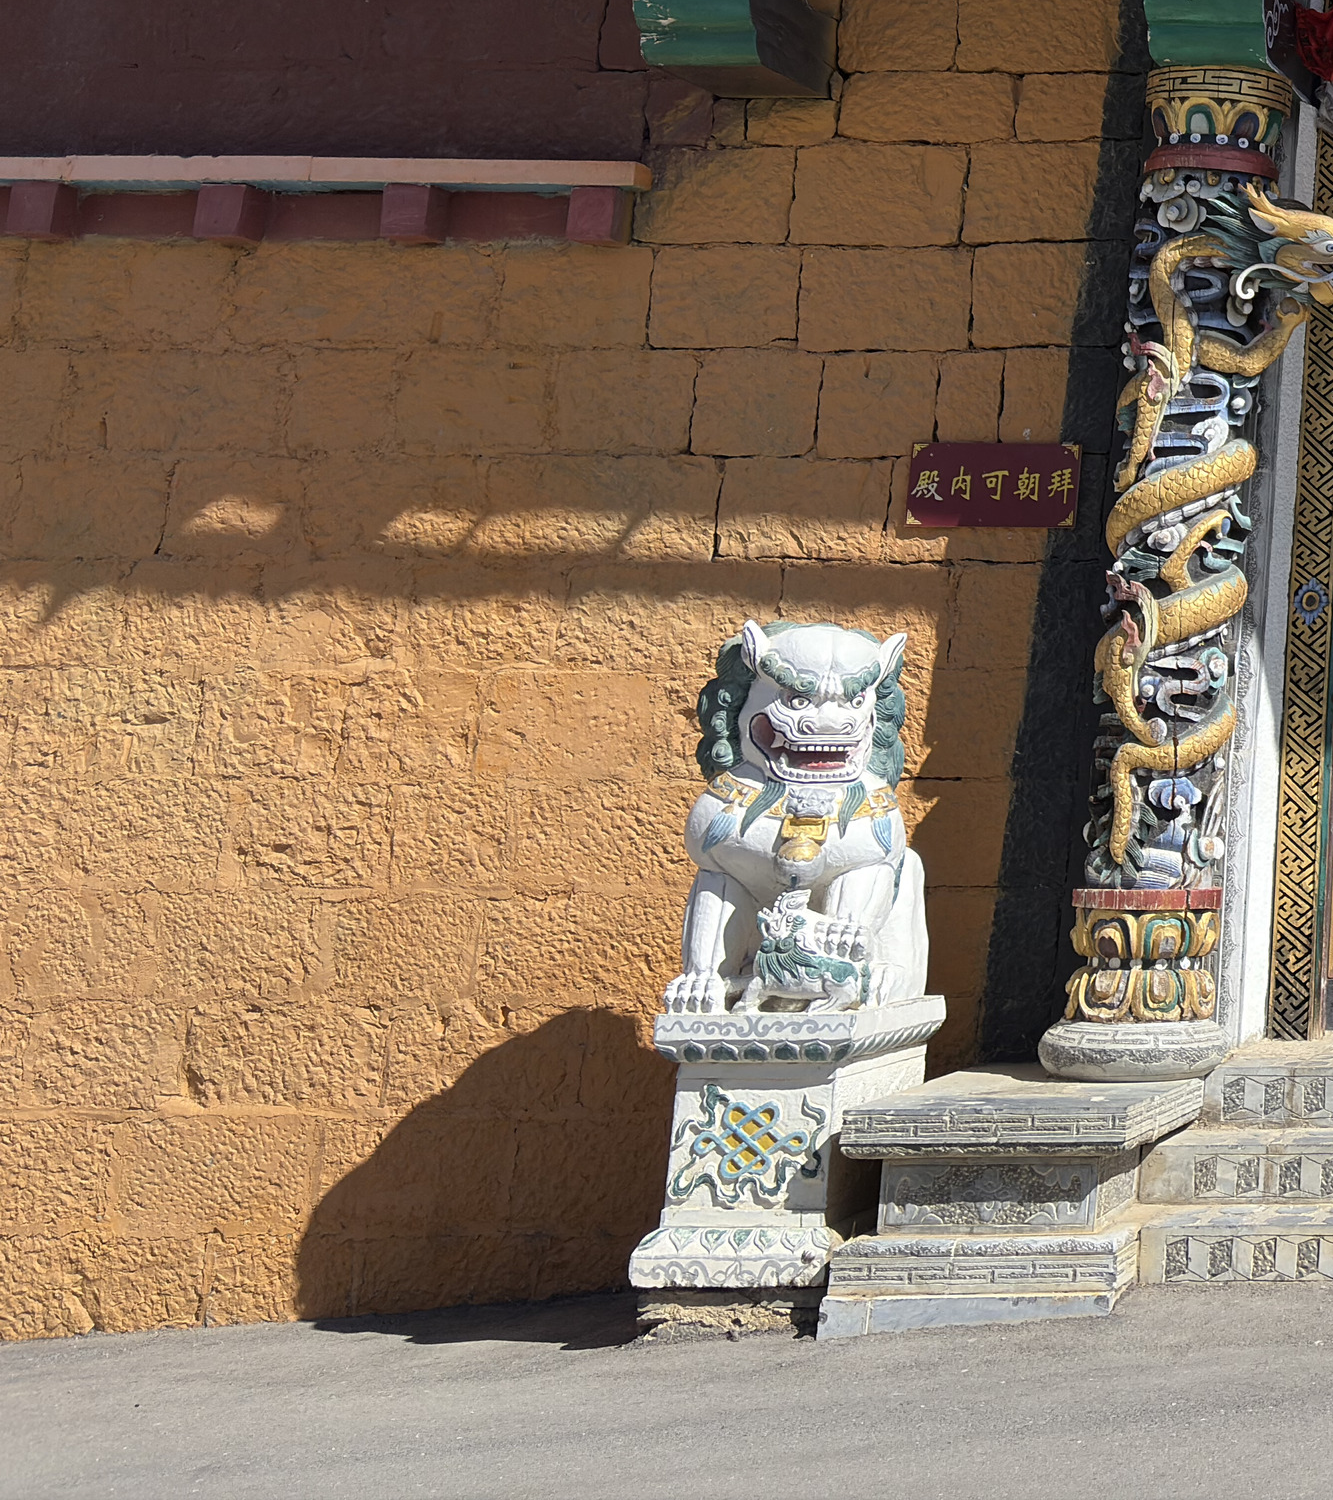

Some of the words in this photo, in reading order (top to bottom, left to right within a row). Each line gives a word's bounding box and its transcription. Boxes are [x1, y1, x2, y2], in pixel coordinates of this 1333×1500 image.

[911, 465, 1074, 504] 殿内可朝拜
